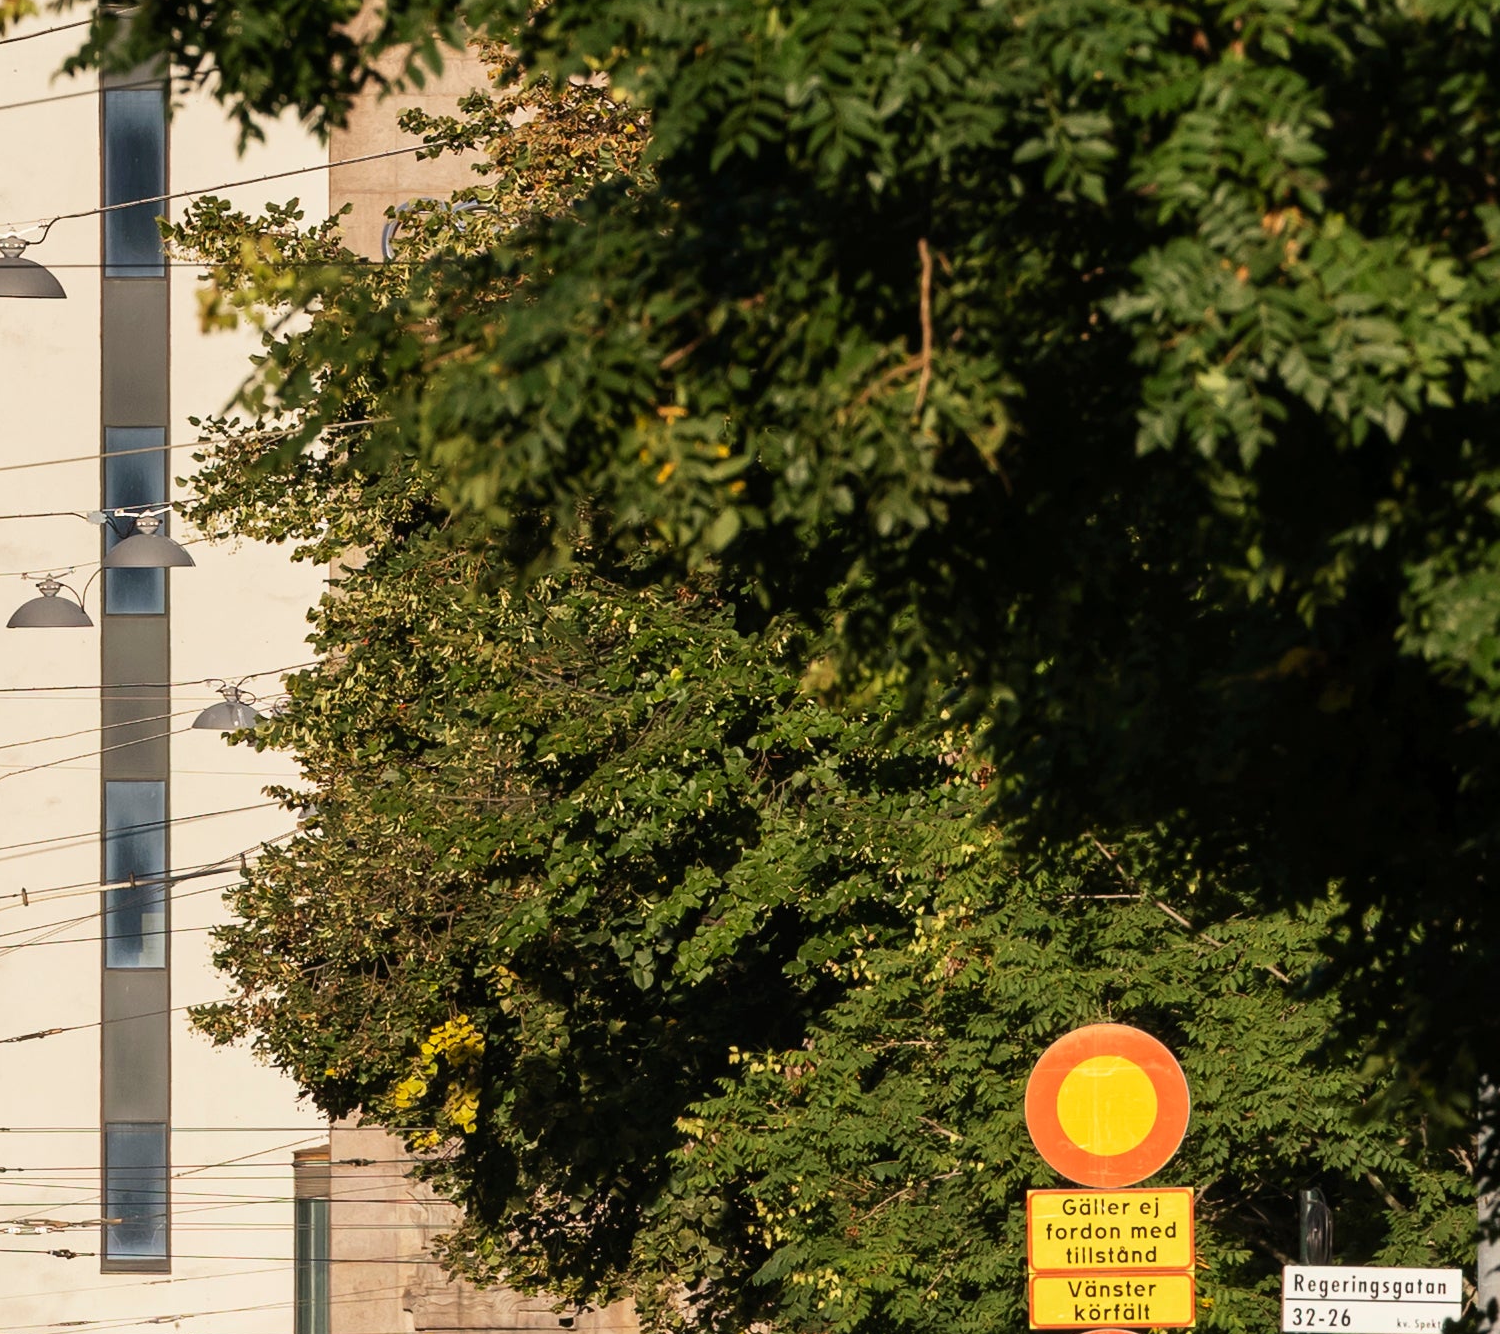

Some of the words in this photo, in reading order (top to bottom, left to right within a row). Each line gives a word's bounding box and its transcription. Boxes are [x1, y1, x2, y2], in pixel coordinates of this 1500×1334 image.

[1062, 1198, 1130, 1216] Gäller
[1140, 1197, 1160, 1218] ej
[1046, 1223, 1121, 1240] fordon
[1131, 1221, 1177, 1239] med
[1066, 1246, 1157, 1264] tillstånd
[1067, 1280, 1157, 1298] Vänster
[1293, 1273, 1447, 1300] Regeringsgatan
[1074, 1303, 1150, 1321] körfält
[1292, 1308, 1351, 1327] 32-26
[1397, 1320, 1411, 1329] kv.
[1414, 1319, 1444, 1331] Spekt
